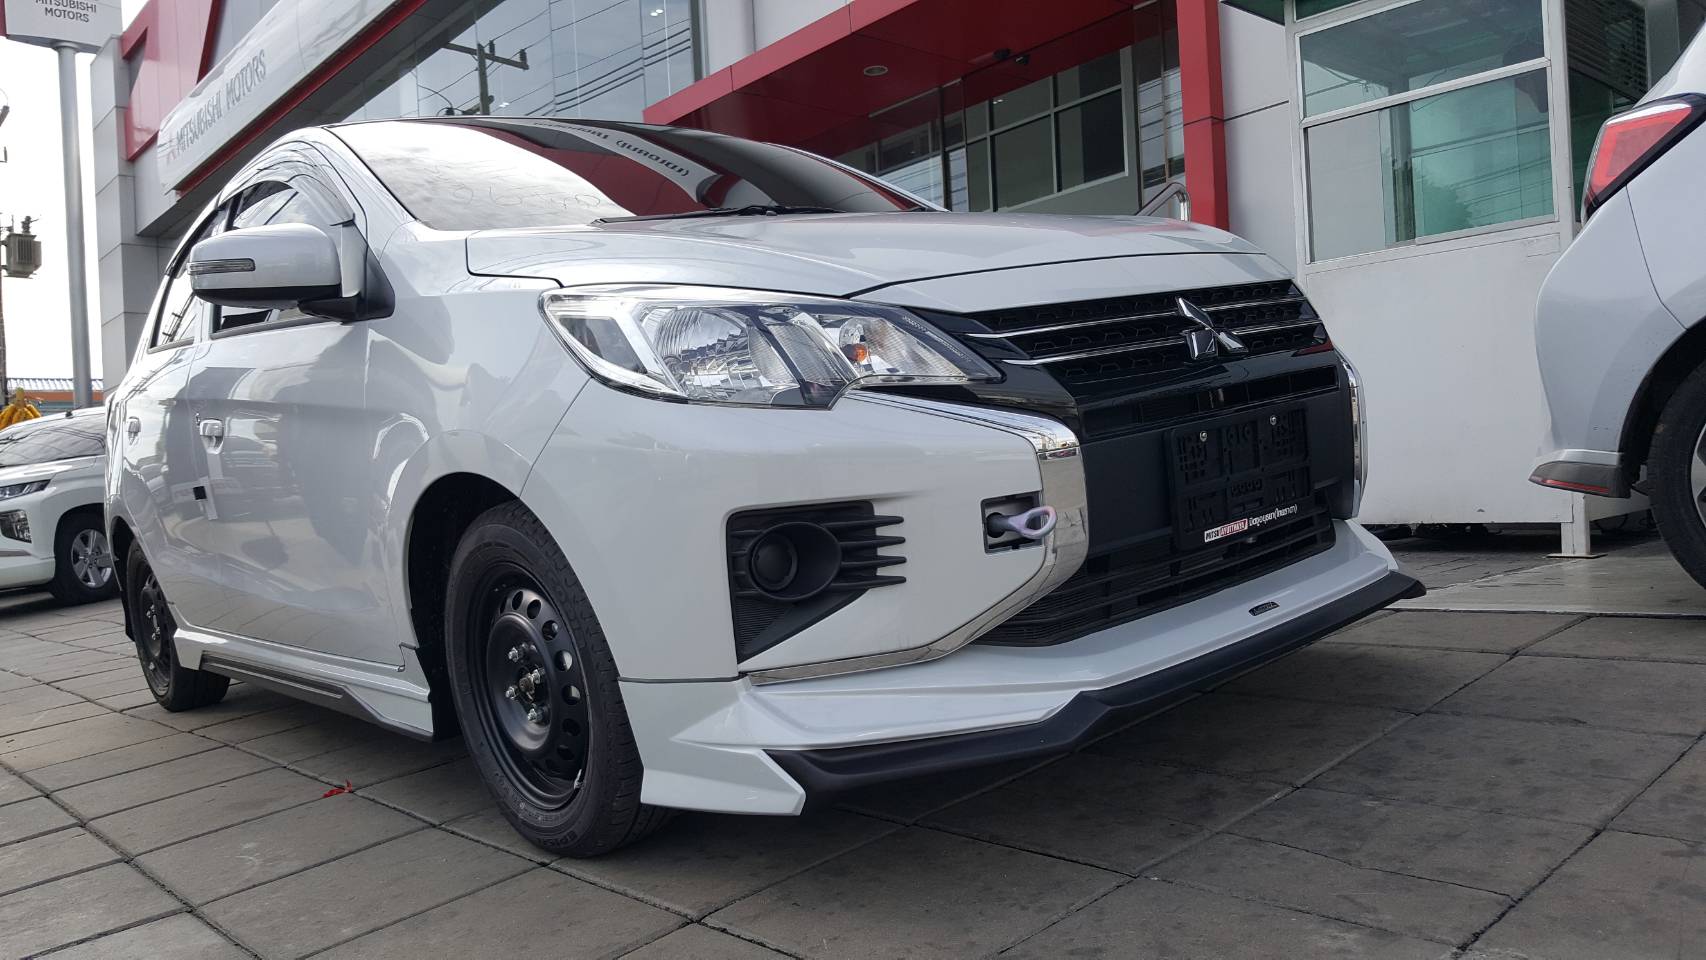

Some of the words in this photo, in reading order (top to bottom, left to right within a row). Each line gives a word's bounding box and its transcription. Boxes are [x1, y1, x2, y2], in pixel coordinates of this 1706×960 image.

[44, 6, 90, 23] MOTORS
[176, 89, 223, 155] MITSUBISHI
[225, 49, 266, 111] MOTORS
